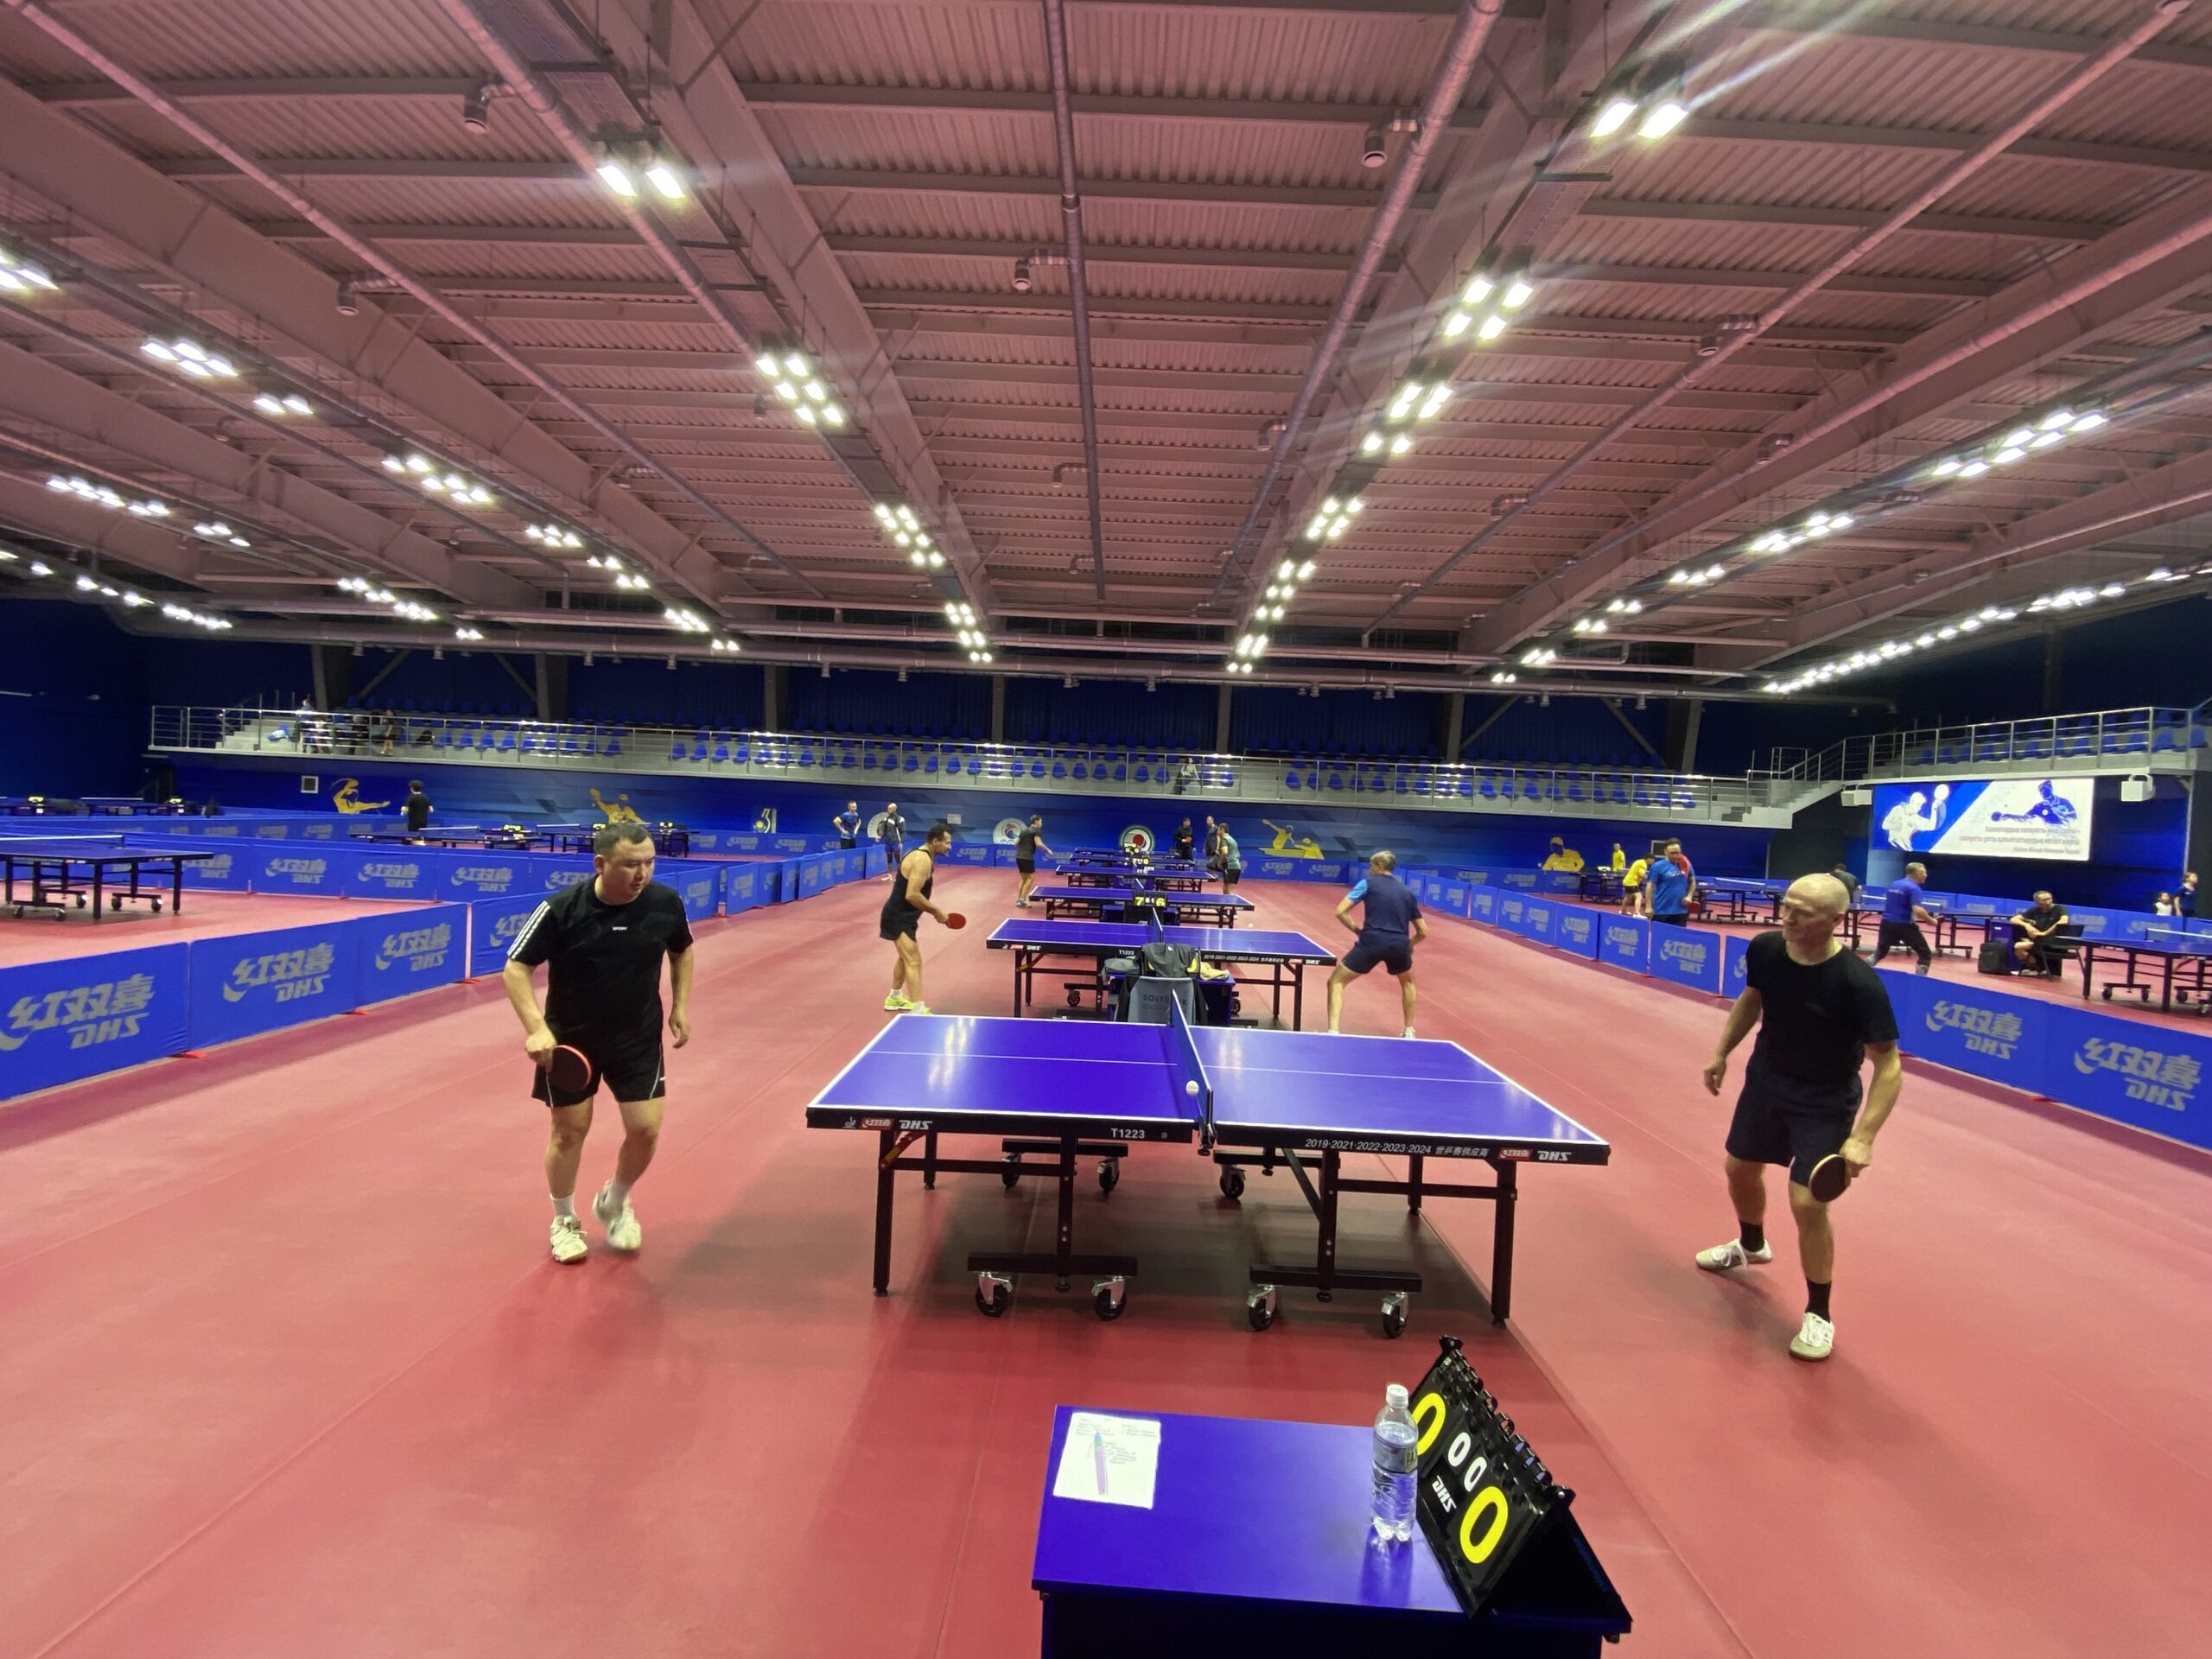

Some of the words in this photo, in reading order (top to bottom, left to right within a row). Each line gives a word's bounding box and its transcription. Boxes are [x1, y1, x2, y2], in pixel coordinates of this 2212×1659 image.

[1135, 896, 1144, 906] 7
[1156, 897, 1166, 906] 6
[375, 923, 452, 970] 红双喜
[409, 950, 448, 972] DHS
[223, 942, 334, 1002] 红双喜
[274, 974, 331, 1002] DHS
[0, 973, 156, 1051] 红双喜
[1925, 1000, 2022, 1041] 红双喜
[67, 1012, 150, 1050] DHS
[1964, 1033, 2018, 1060] DHS
[2074, 1037, 2202, 1090] 红双喜
[2124, 1077, 2195, 1111] DHS
[899, 1120, 933, 1130] DHS
[1110, 1128, 1146, 1140] T1223
[1537, 1150, 1572, 1161] DHS
[1448, 1432, 1471, 1467] 0
[1464, 1456, 1487, 1491] 0
[1431, 1475, 1457, 1513] DHS
[1459, 1486, 1509, 1563] 0
